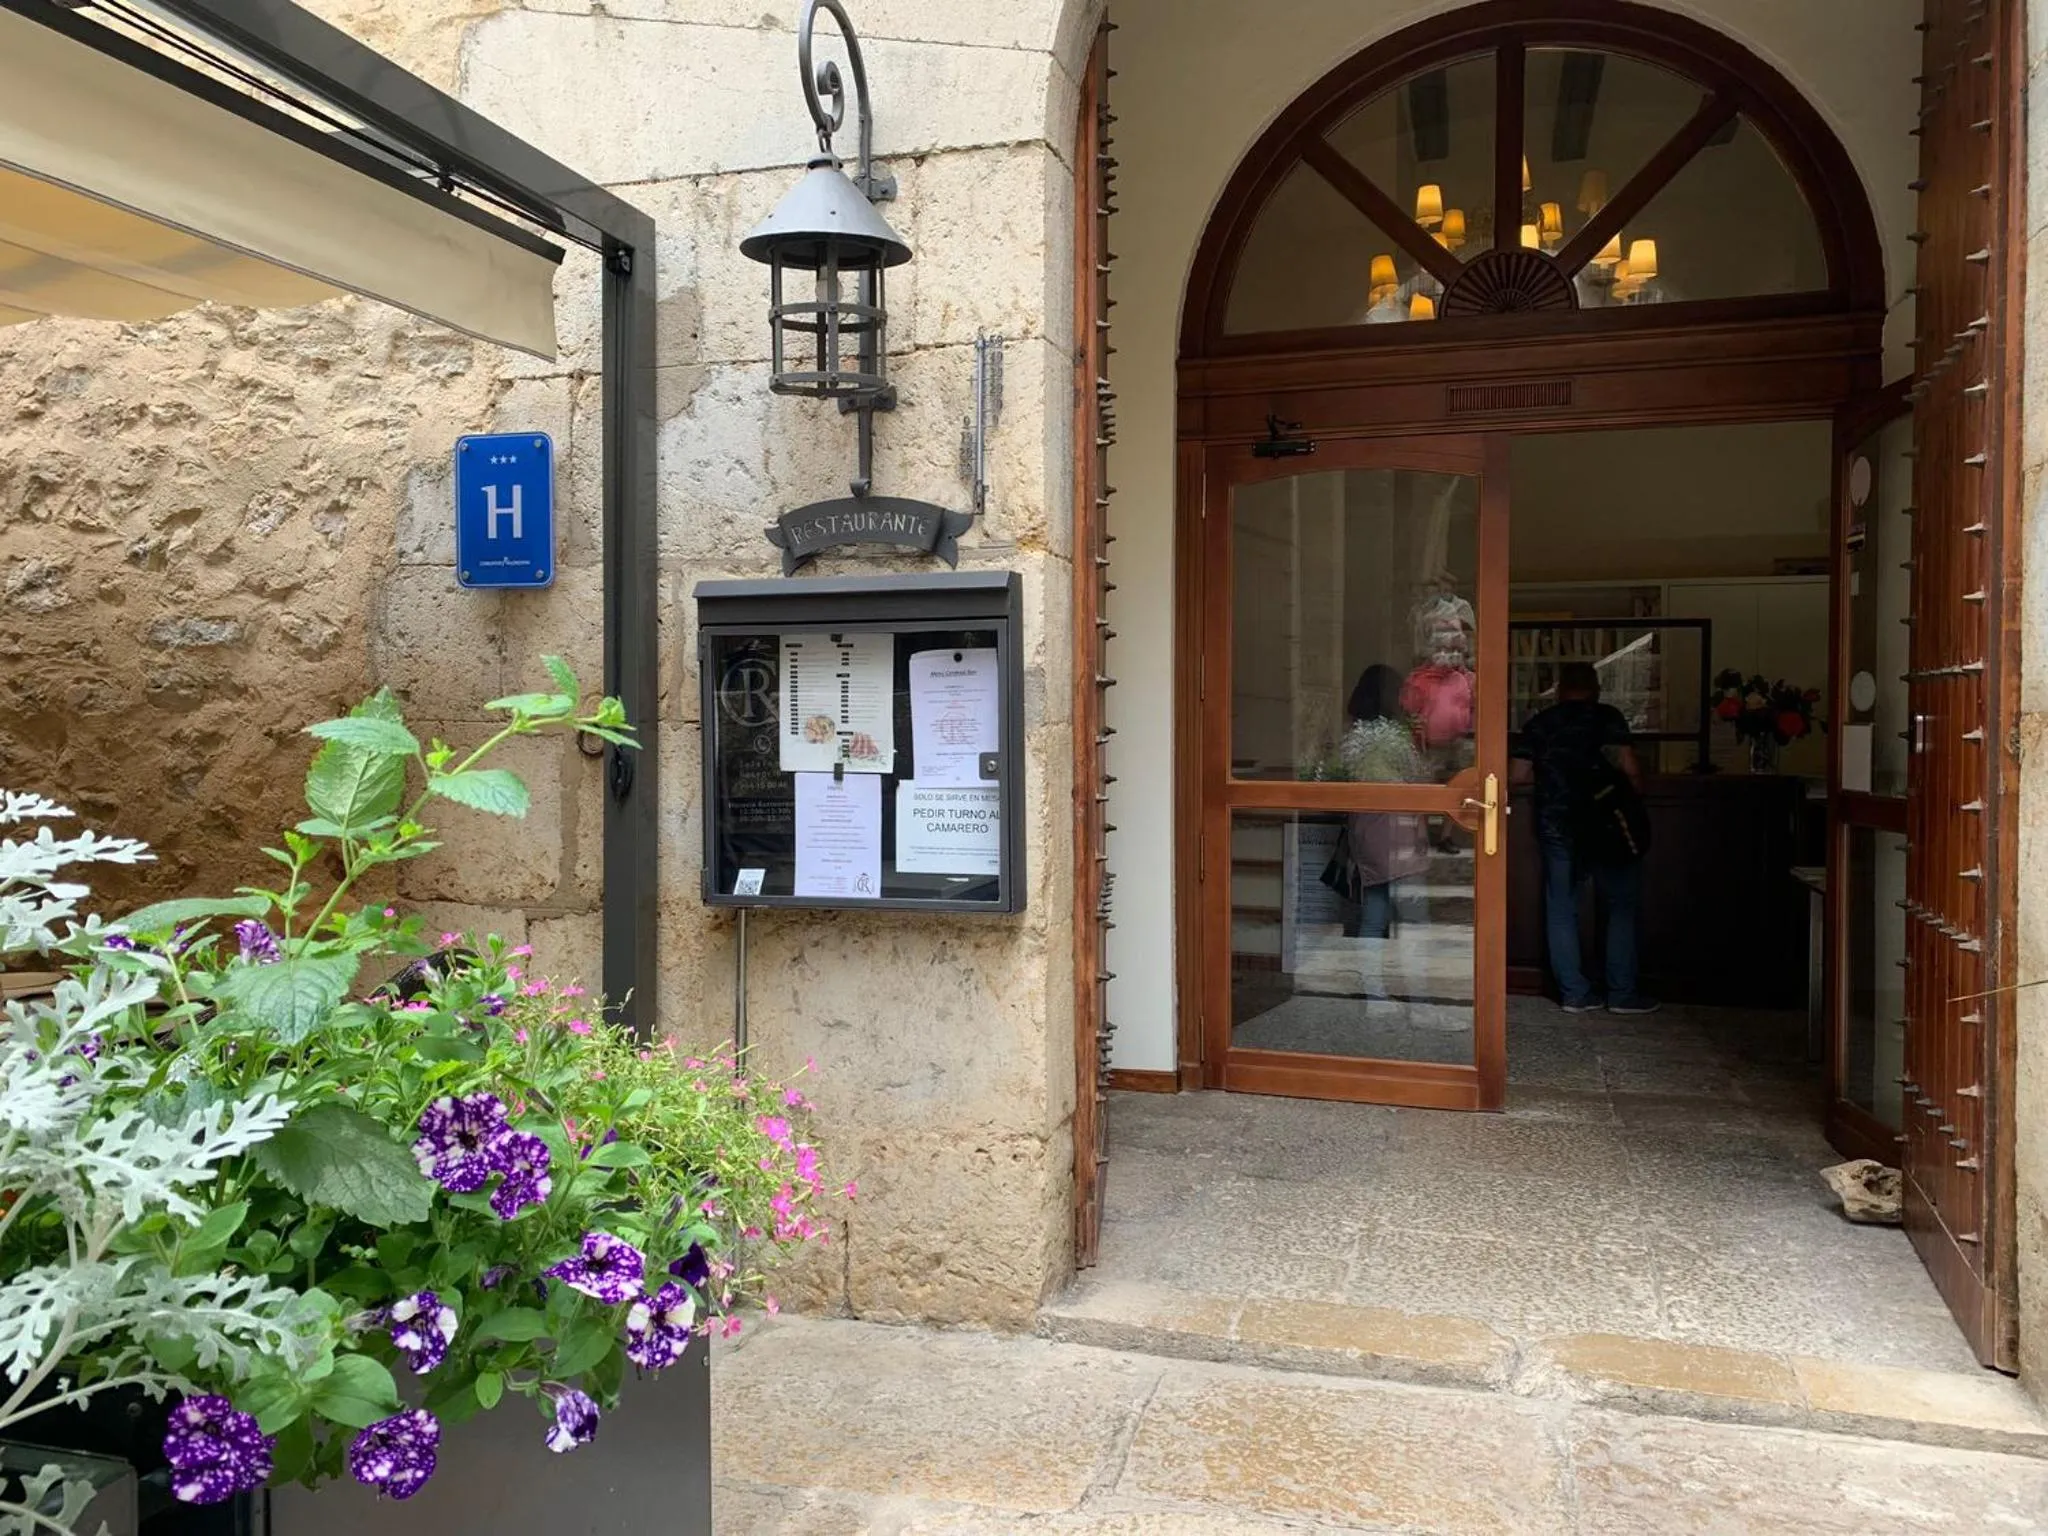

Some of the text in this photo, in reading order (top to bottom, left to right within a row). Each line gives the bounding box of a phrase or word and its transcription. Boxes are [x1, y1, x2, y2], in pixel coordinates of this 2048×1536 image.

[481, 484, 523, 539] H
[791, 512, 930, 544] RESTAURANTE
[913, 792, 933, 801] SOLO
[935, 793, 945, 801] SE
[946, 793, 967, 802] SIRVE
[969, 793, 979, 802] EN
[913, 808, 1000, 820] PEDIR TURNO AL
[926, 822, 989, 834] CAMARERO
